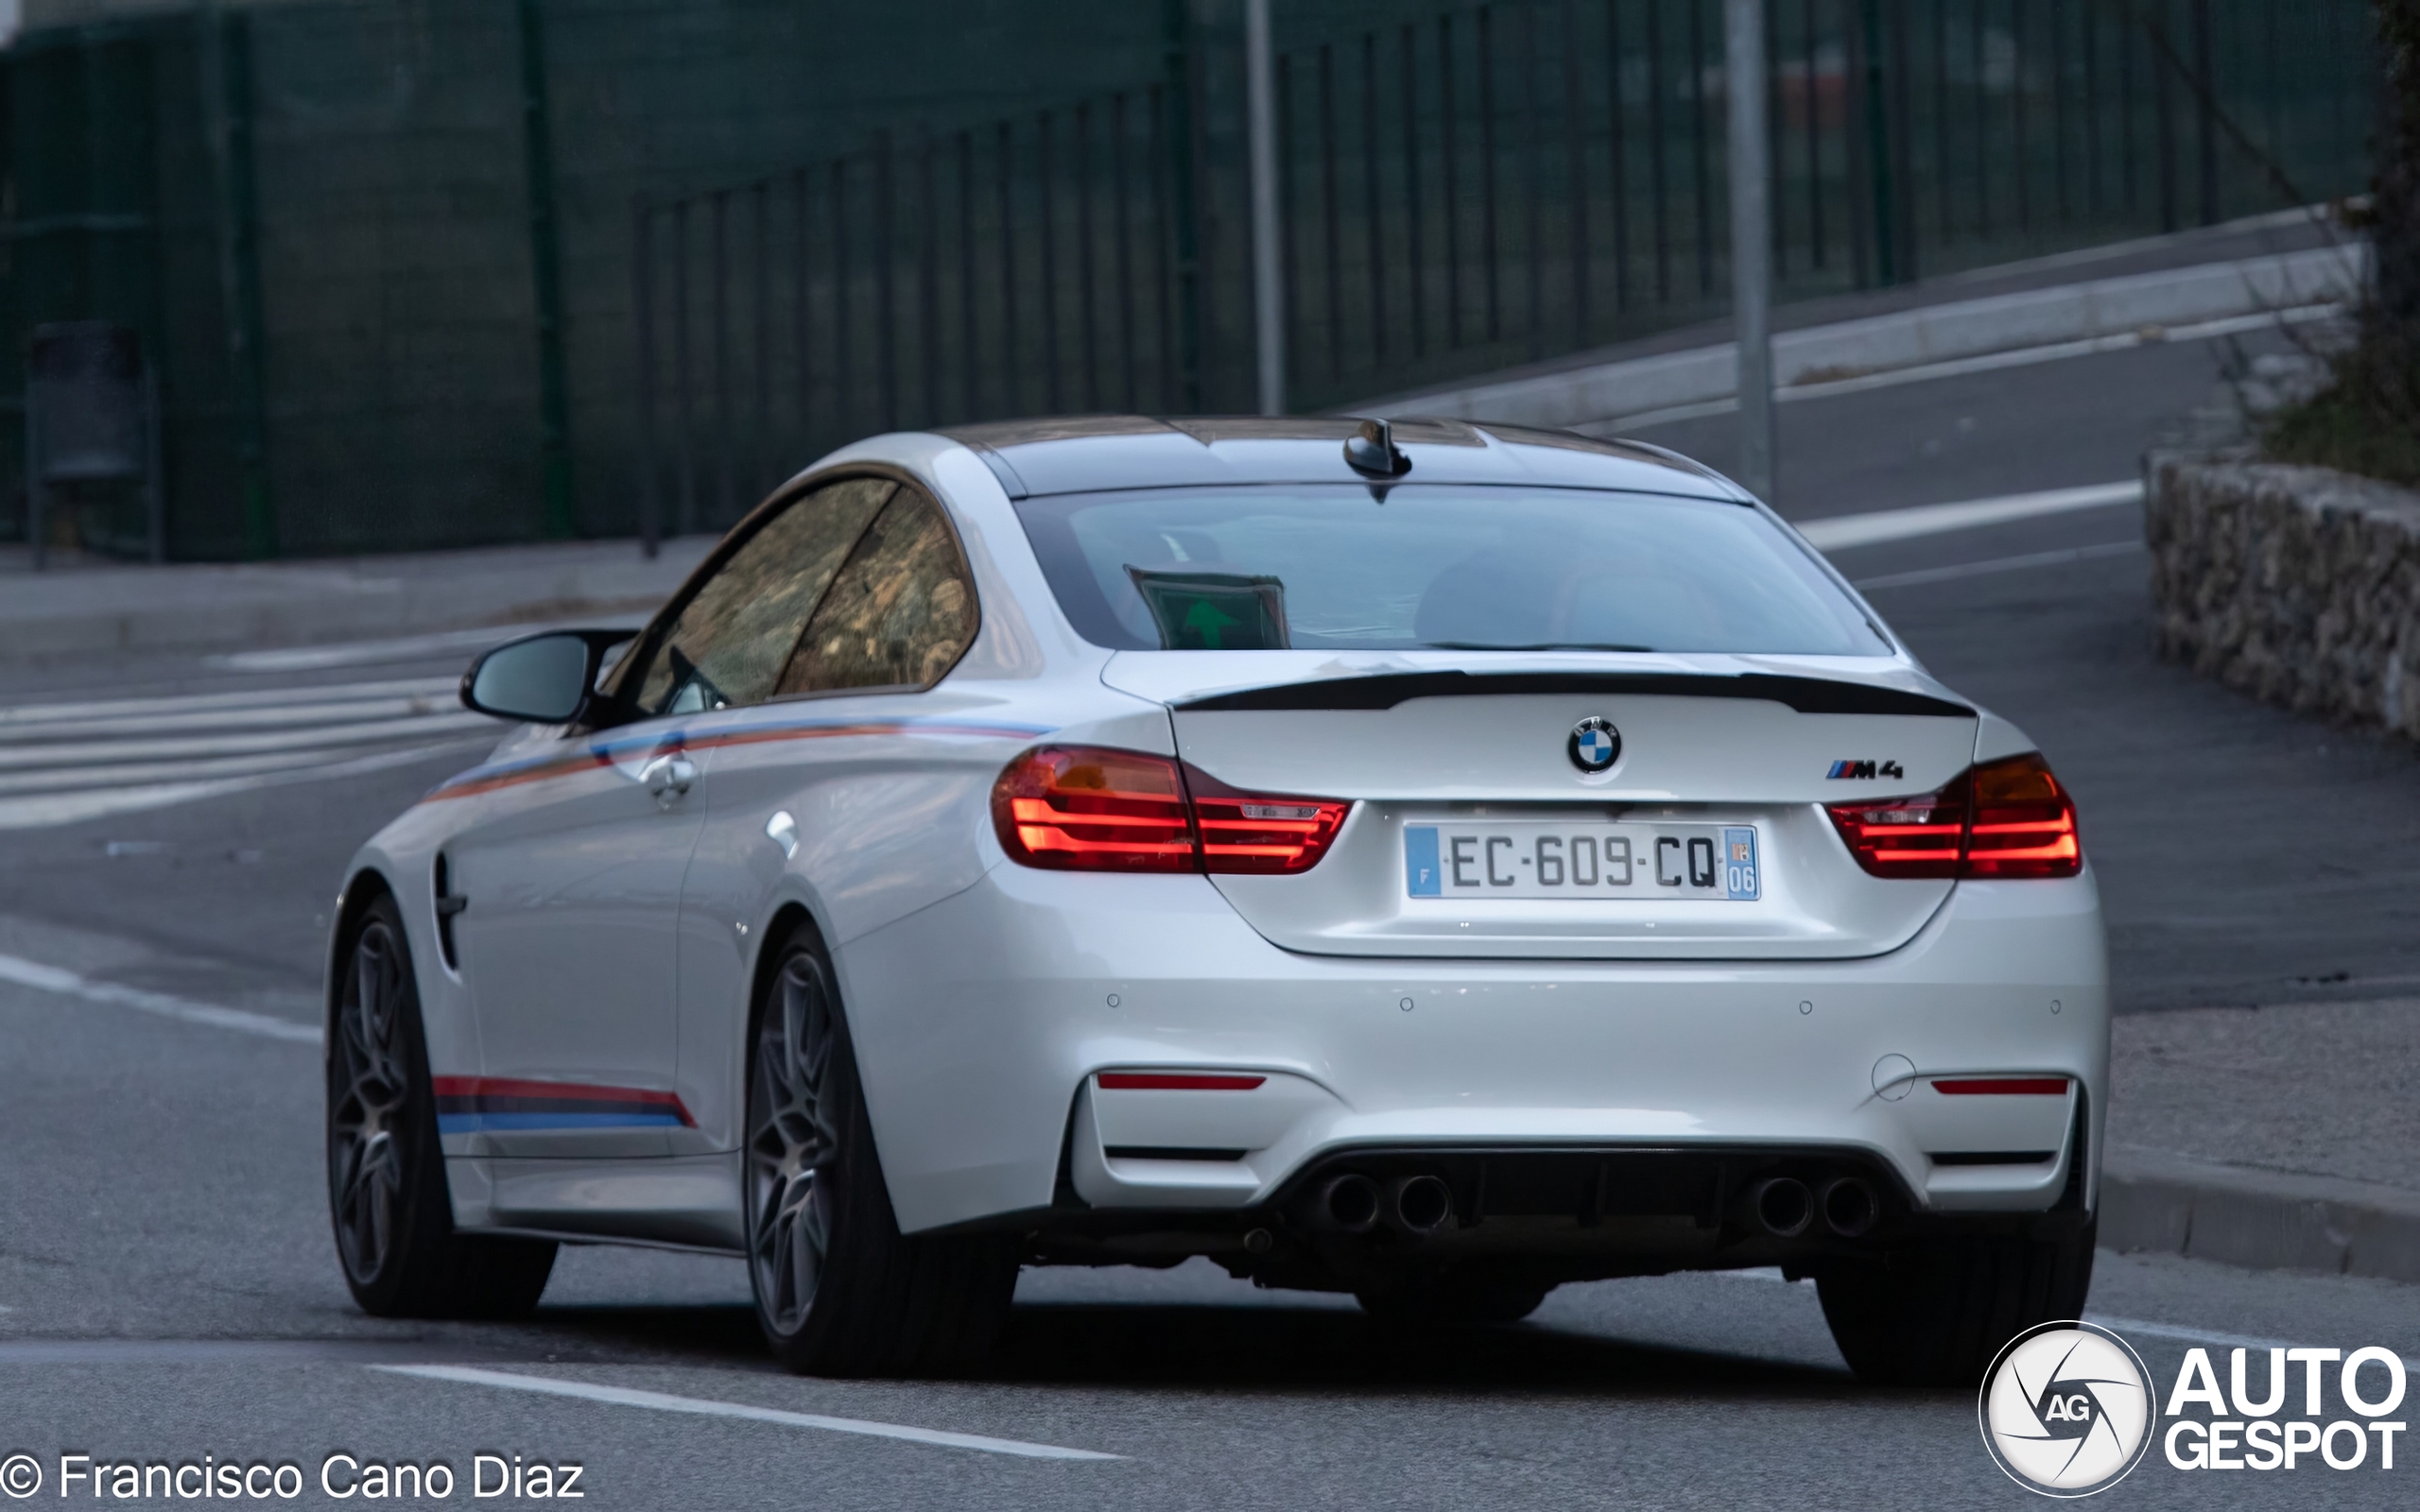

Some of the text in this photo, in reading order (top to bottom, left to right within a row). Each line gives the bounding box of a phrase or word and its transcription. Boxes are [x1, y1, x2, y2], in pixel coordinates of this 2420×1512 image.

[1450, 835, 1717, 887] EC-609-CQ
[1419, 868, 1431, 884] F
[1728, 866, 1756, 893] 06
